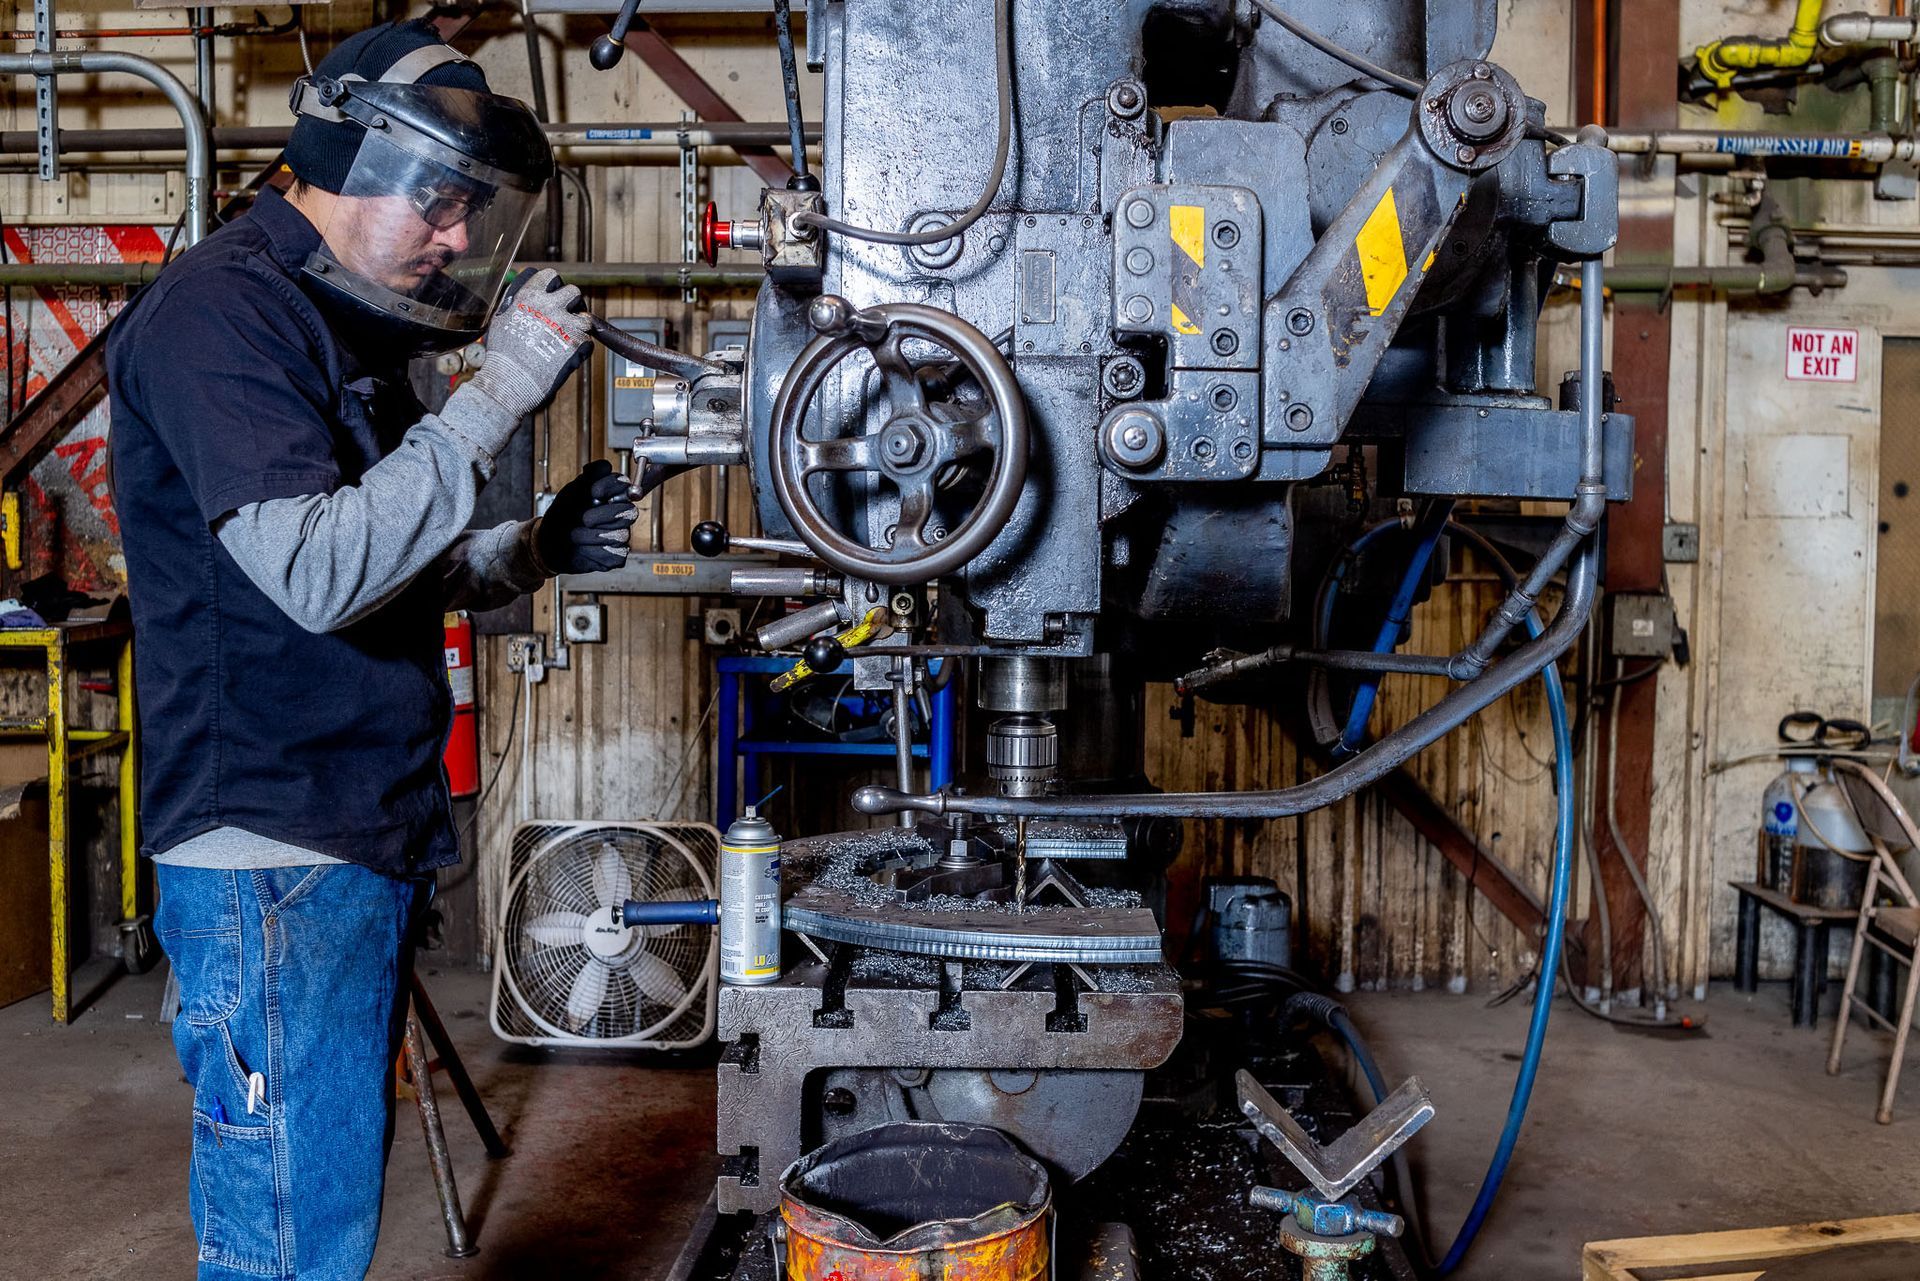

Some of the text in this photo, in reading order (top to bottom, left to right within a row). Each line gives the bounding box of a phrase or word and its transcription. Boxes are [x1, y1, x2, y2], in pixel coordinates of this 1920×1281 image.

[1722, 136, 1847, 157] COMPRESSED AIR
[1792, 333, 1853, 354] NOT AN
[1803, 356, 1840, 376] EXIT
[672, 565, 693, 576] VOLTS
